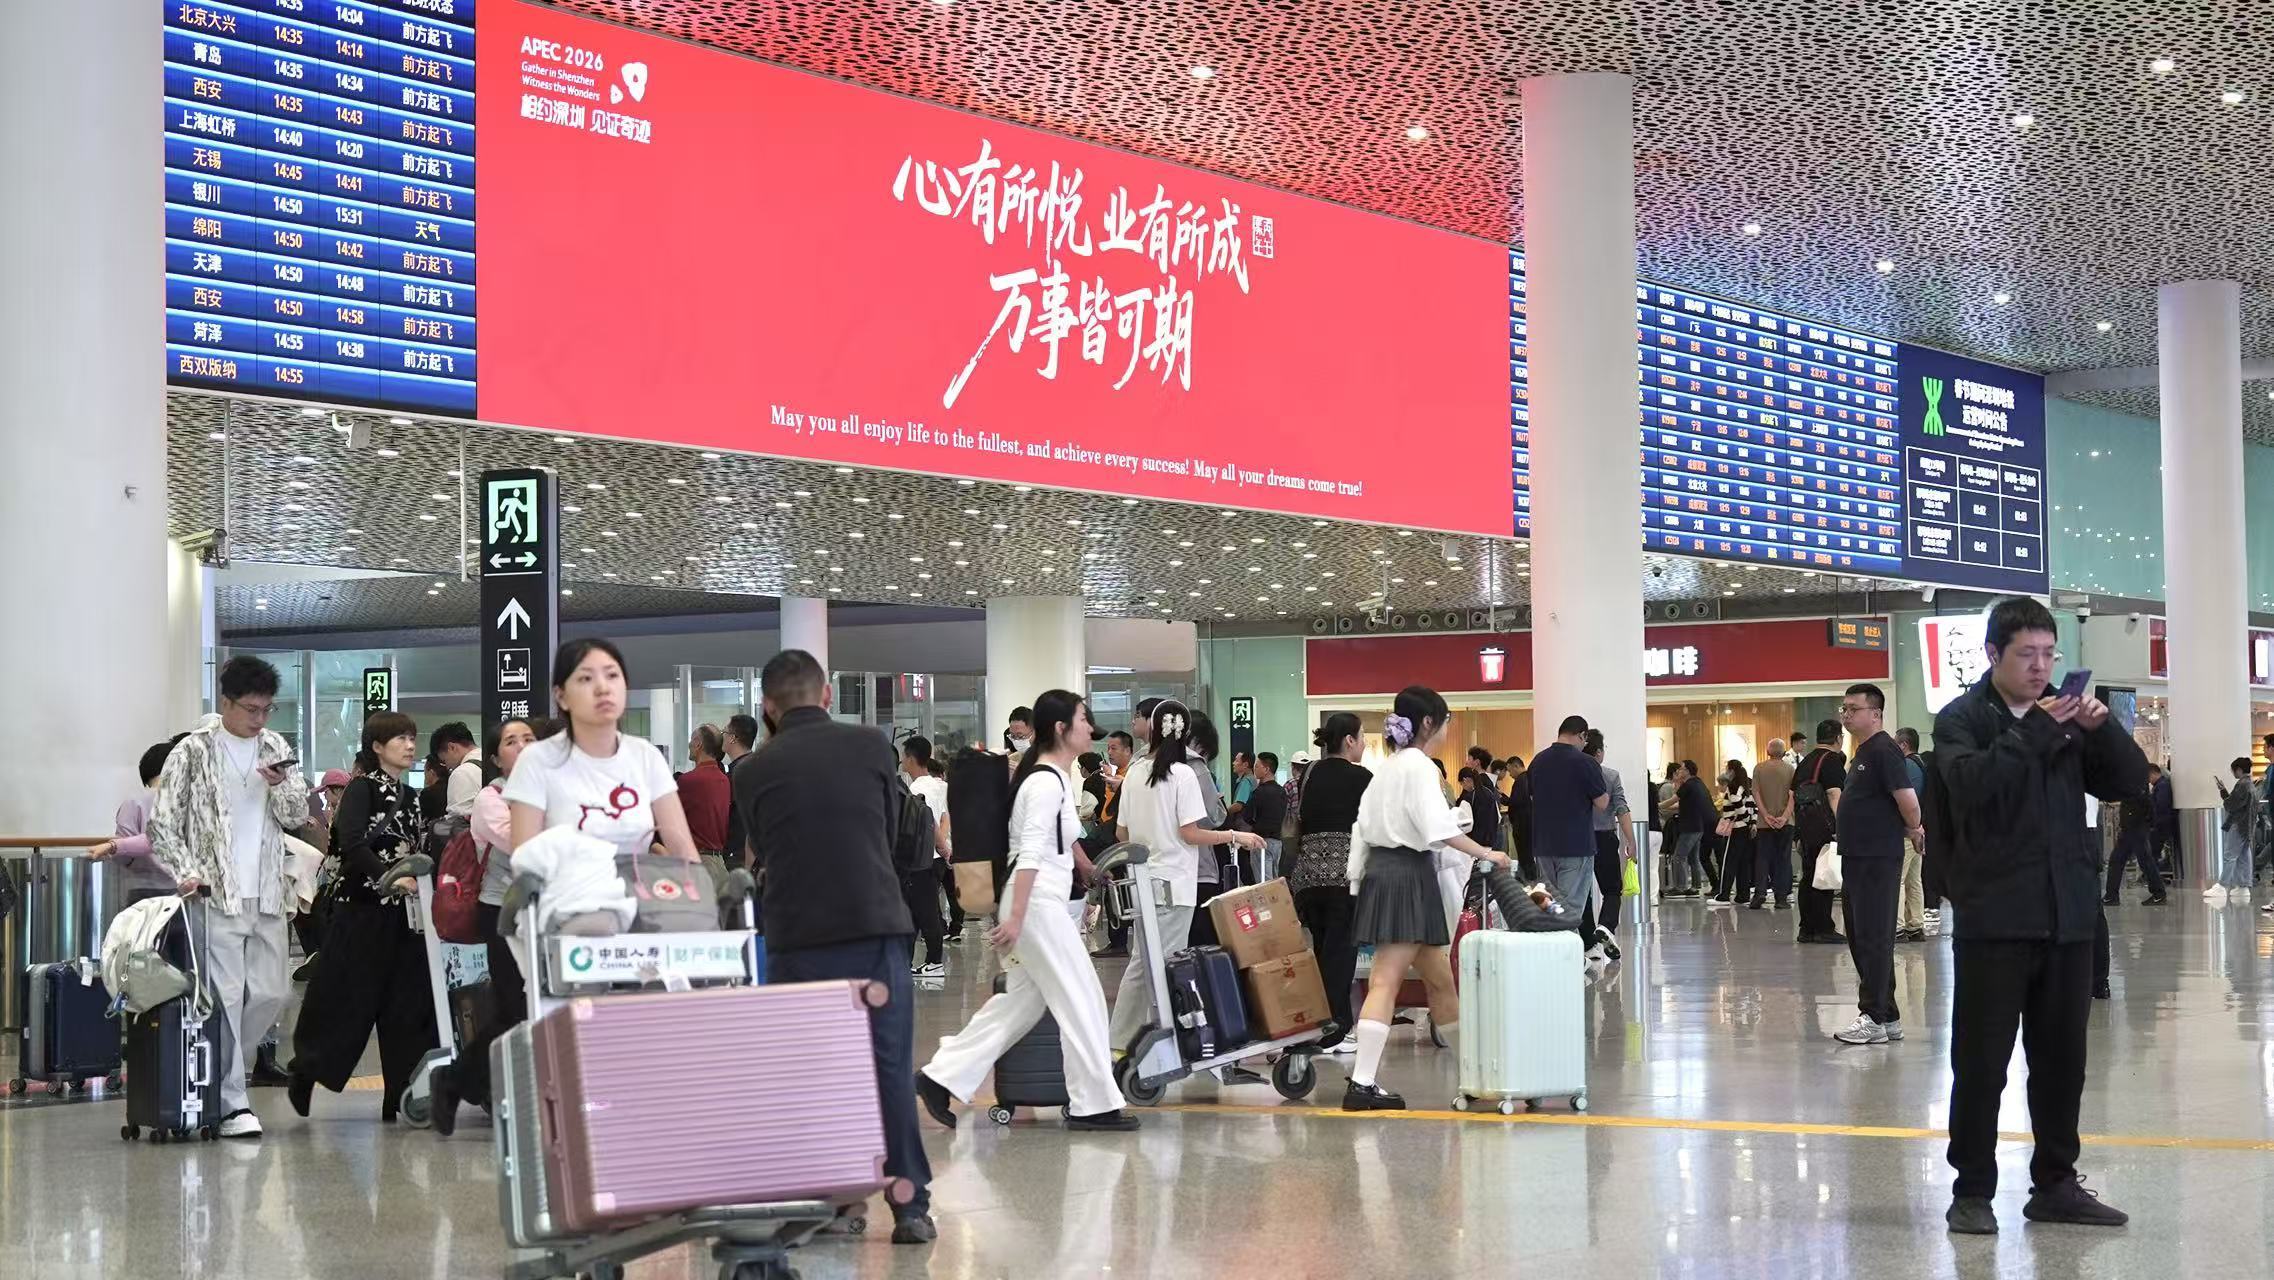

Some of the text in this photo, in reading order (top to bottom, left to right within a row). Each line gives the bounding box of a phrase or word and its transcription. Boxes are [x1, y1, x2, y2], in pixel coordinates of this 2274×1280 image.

[335, 5, 364, 26] 14:04
[402, 21, 453, 48] 前方起飞
[402, 0, 454, 14] 状态
[178, 3, 453, 82] 北京大兴 14:35 14:14 前方起飞
[520, 35, 604, 71] APEC 2026
[192, 42, 453, 114] 青岛 14:35 14:34 前方起飞
[521, 61, 594, 86] Gather in Shenzhen
[521, 75, 600, 101] Witness the Wonders
[192, 77, 453, 146] 西安 14:35 14:43 前方起飞
[520, 93, 651, 144] 相约深圳 见证奇迹
[178, 109, 453, 179] 上海虹桥 14:40 14:20 前方起飞
[192, 148, 453, 211] 无锡 14:45 14:41 前方起飞
[192, 182, 441, 242] 银川 14:50 15:31 天气
[892, 138, 1250, 294] 心有所悦 业有所成
[192, 217, 453, 276] 绵阳 14:50 14:42 前方起飞
[192, 251, 223, 274] 天津
[273, 264, 303, 283] 14:50
[403, 284, 454, 308] 前方起飞
[192, 287, 454, 340] 西安 14:50 14:58 前方起飞
[943, 260, 1194, 409] 万事皆可期
[179, 354, 304, 384] 西双版纳 14:55
[274, 333, 303, 351] 14:55
[403, 350, 454, 373] 前方起飞
[770, 404, 1363, 497] May you all enjoy life to the fullest, and achieve every success! May all your dreams come true!
[1643, 646, 1698, 676] 咖啡
[599, 947, 740, 961] 中国人寿 财产保险
